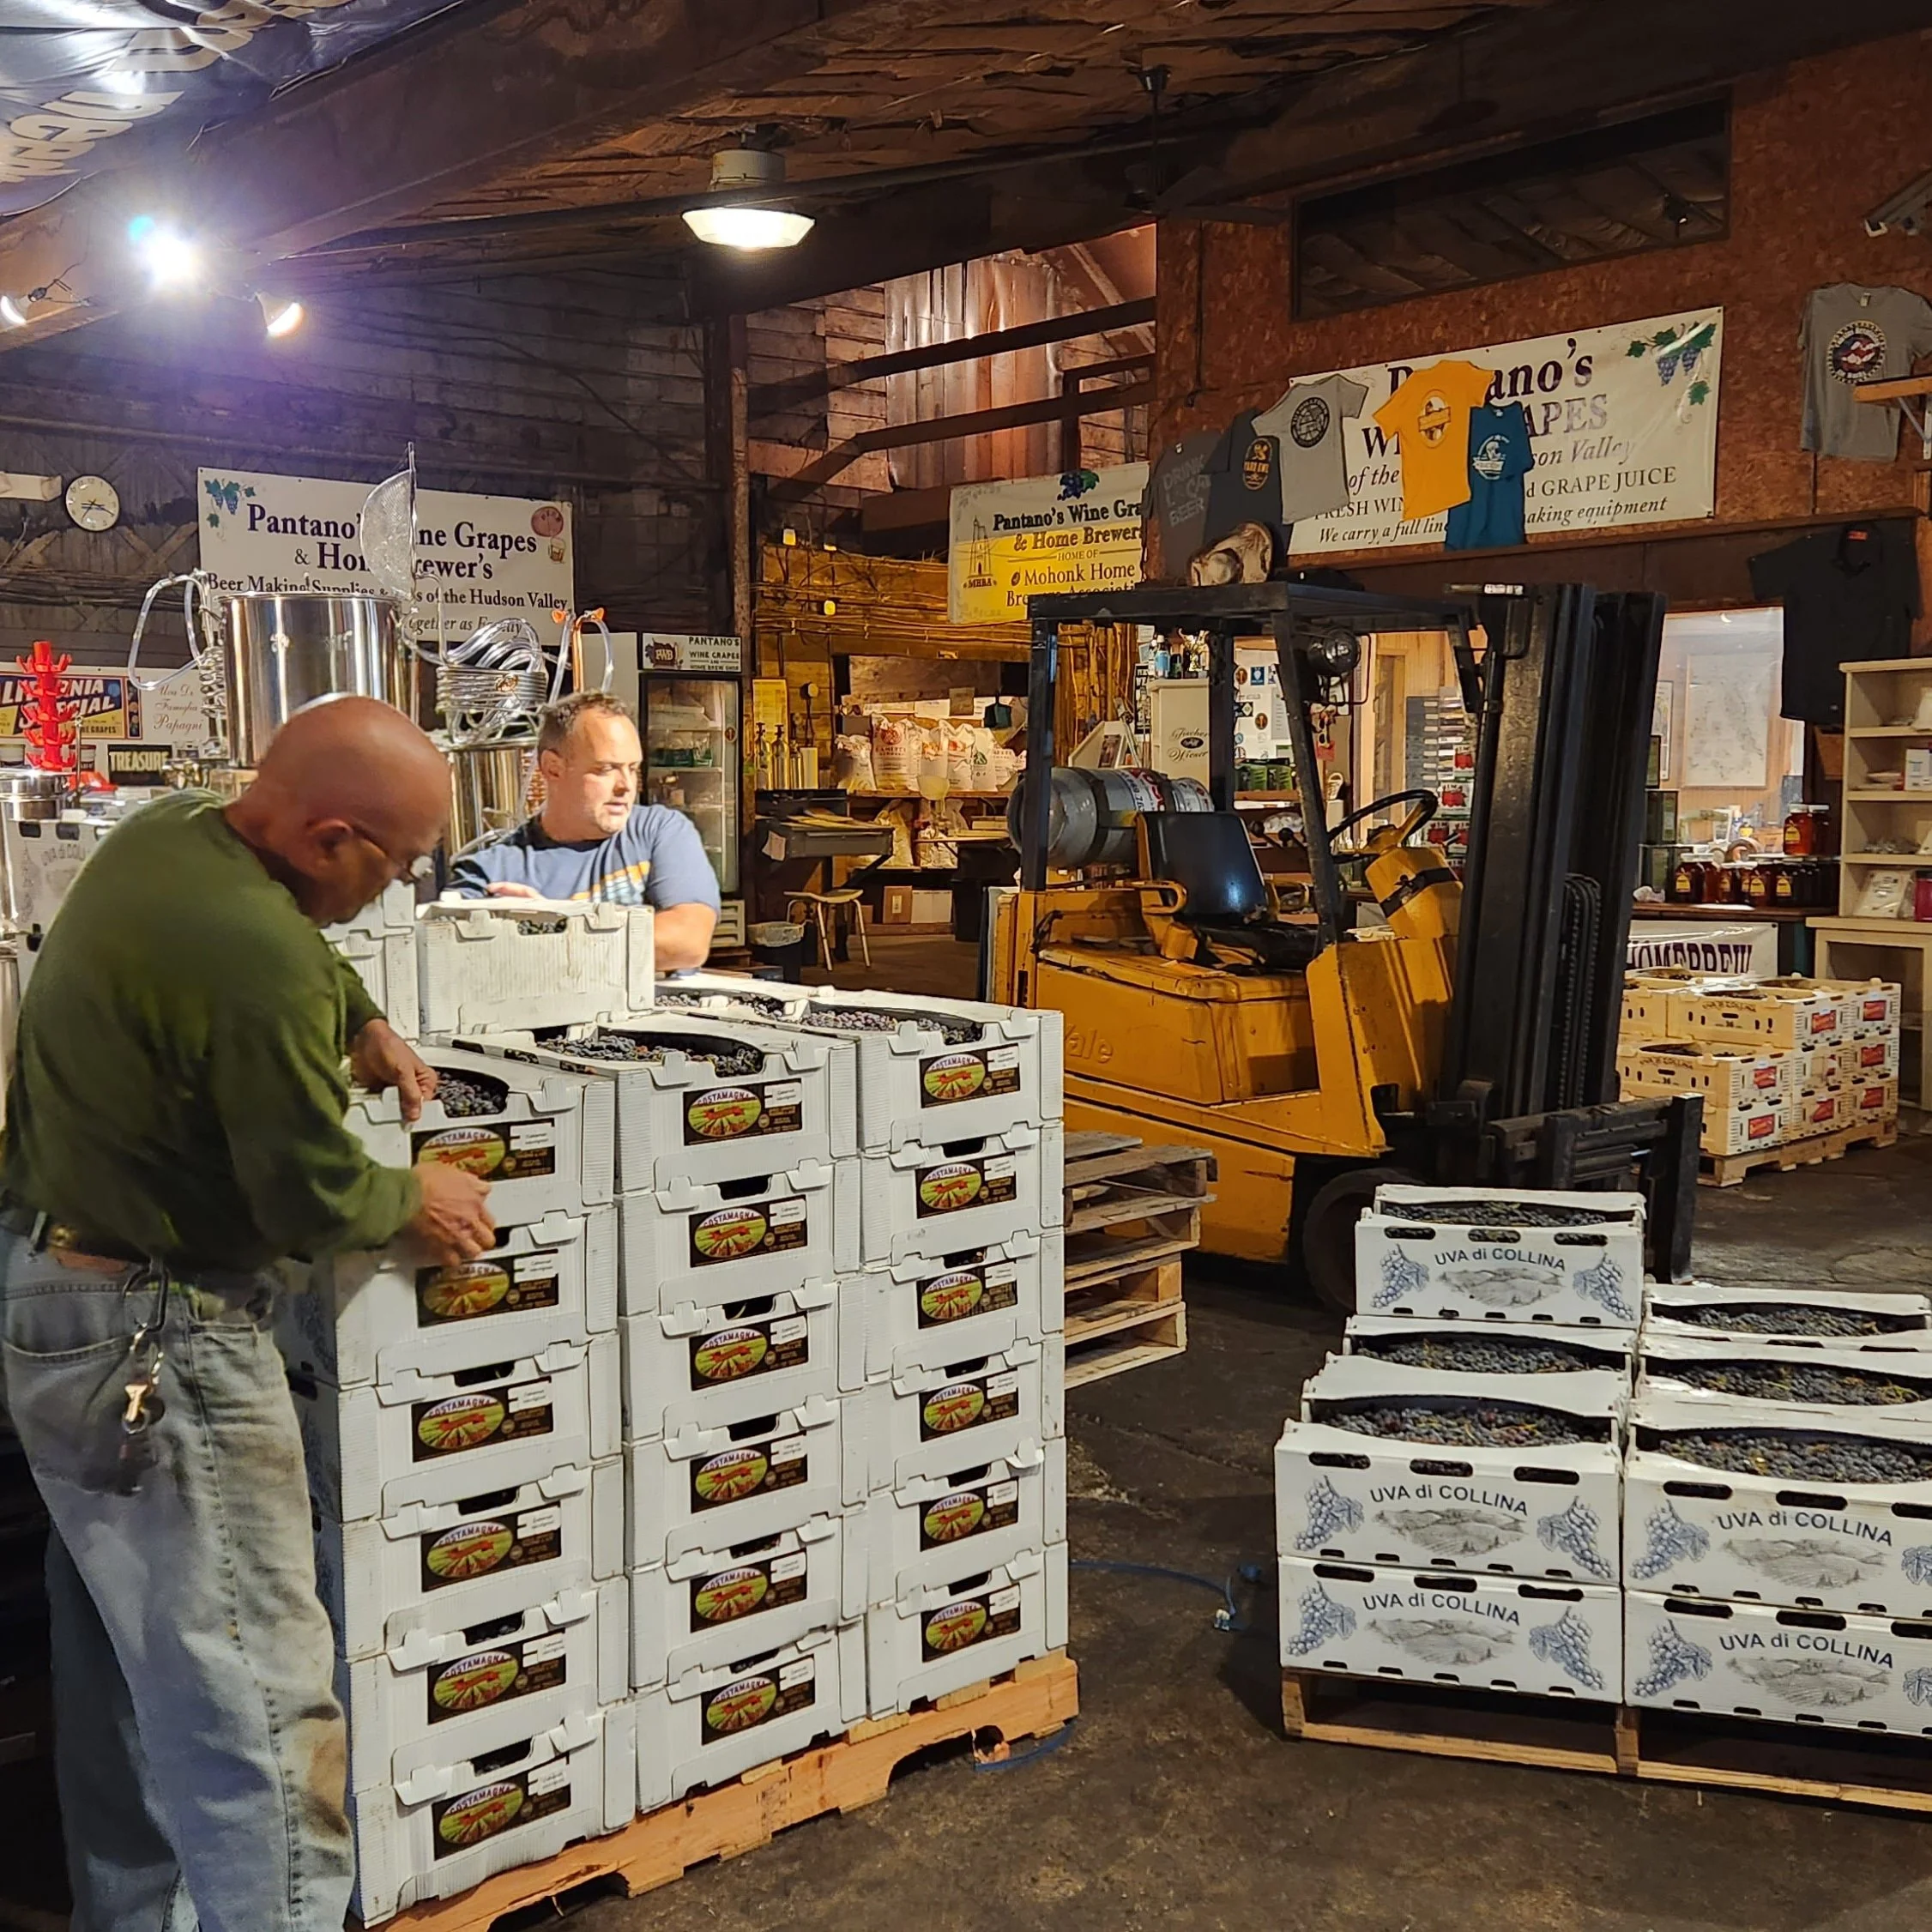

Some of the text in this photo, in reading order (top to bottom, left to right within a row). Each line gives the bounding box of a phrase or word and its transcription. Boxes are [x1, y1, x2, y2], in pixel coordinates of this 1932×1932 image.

[1361, 394, 1608, 459] WI APES
[1349, 466, 1368, 495] of
[1371, 464, 1400, 486] the
[1541, 474, 1610, 497] GRAPE
[1613, 466, 1677, 493] JUICE
[993, 499, 1143, 531] Pantano's Wine Gra
[1168, 498, 1205, 527] BEER
[1319, 528, 1338, 543] We
[1342, 528, 1380, 545] carry
[1382, 528, 1391, 538] a
[1391, 518, 1419, 542] full
[1526, 506, 1573, 526] aking
[1577, 497, 1668, 525] equipment
[247, 503, 537, 559] Pantano' ne Grapes
[1013, 533, 1027, 552] &
[1032, 531, 1078, 550] Home
[294, 541, 493, 580] & Ho rewer's
[1057, 549, 1099, 562] HOME OF
[1024, 562, 1136, 587] Mohonk Home
[207, 572, 244, 592] Beer
[443, 588, 467, 604] the
[469, 589, 525, 607] Hudson
[527, 592, 568, 611] Valley
[459, 619, 472, 630] as
[689, 637, 740, 647] PANTANO'S
[154, 714, 204, 734] Papagni
[1434, 1247, 1566, 1271] UVA di COLLINA
[1370, 1484, 1528, 1517] UVA di COLLINA
[1717, 1510, 1893, 1547] UVA di COLLINA
[1362, 1592, 1520, 1626] UVA di COLLINA
[1719, 1633, 1893, 1669] UVA di COLLINA
